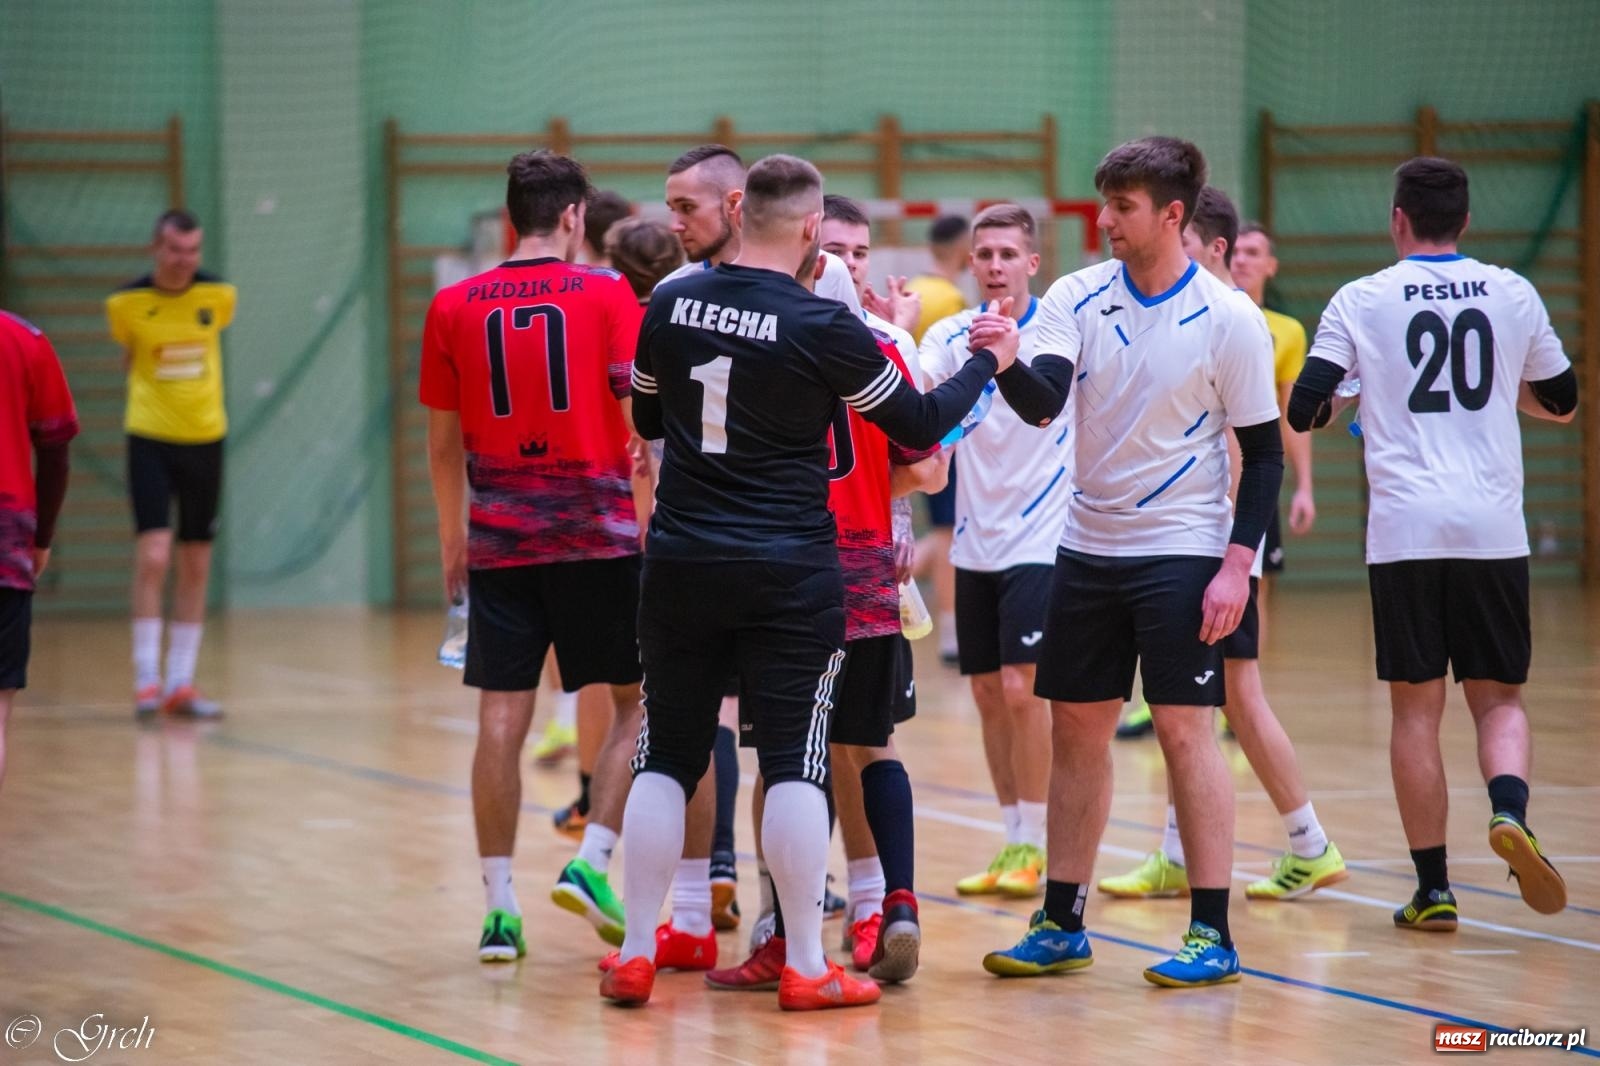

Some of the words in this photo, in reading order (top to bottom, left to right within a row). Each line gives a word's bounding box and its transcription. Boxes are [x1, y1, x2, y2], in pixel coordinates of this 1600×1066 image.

[558, 277, 584, 293] JR
[670, 298, 778, 342] KLECHA
[1404, 281, 1489, 301] PESLIK
[485, 303, 570, 418] 17
[1406, 308, 1495, 413] 20
[689, 355, 733, 454] 1
